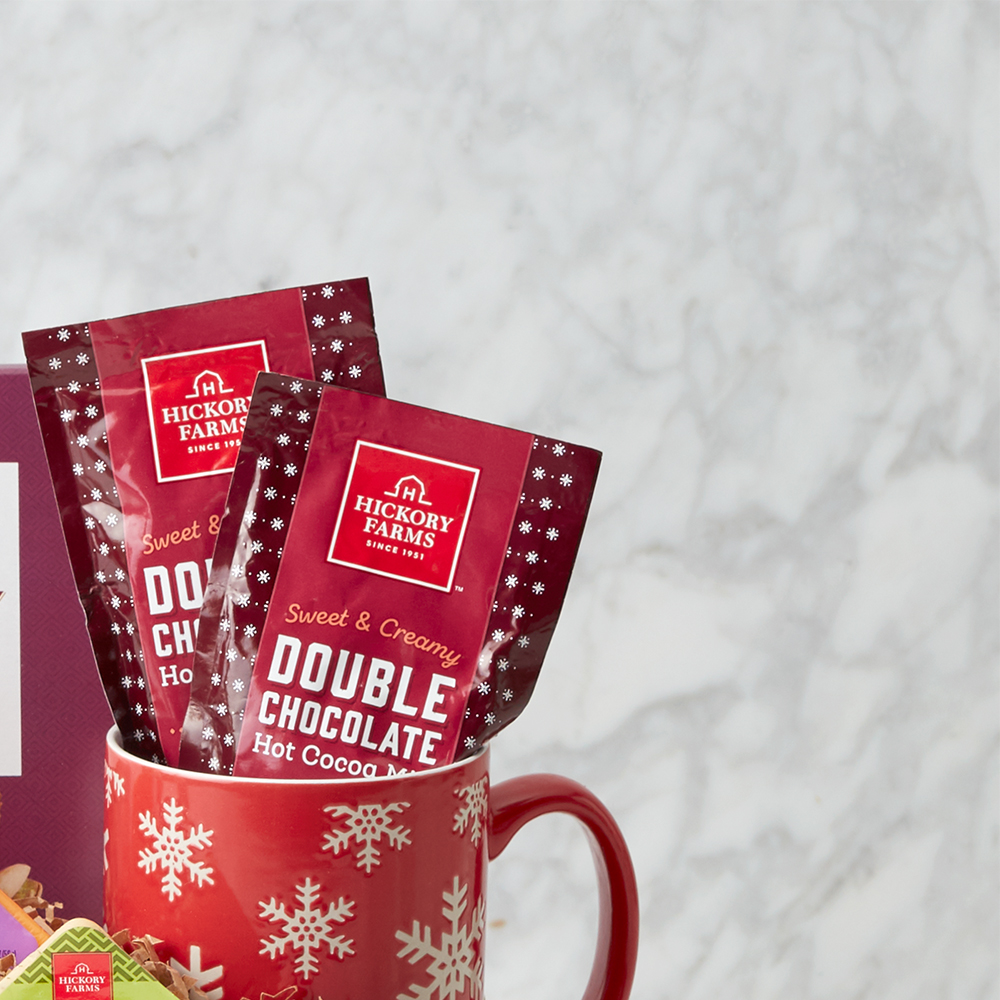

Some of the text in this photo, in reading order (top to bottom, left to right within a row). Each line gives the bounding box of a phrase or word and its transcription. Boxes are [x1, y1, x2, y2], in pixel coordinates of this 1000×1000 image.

[178, 416, 247, 441] FARMS
[188, 439, 241, 454] SINCE 195
[353, 495, 454, 533] HICKORY
[143, 514, 220, 555] Sweet &
[362, 517, 435, 549] FARMS
[366, 539, 425, 561] SINCE 1951
[285, 602, 461, 668] Sweet & Creamy
[159, 664, 193, 687] Ho
[267, 634, 456, 724] DOUBLE
[258, 690, 442, 766] CHOCOLATE
[252, 732, 296, 761] Hot
[301, 744, 377, 778] Cocoa
[59, 976, 106, 985] HICKORY
[66, 984, 100, 993] FARMS
